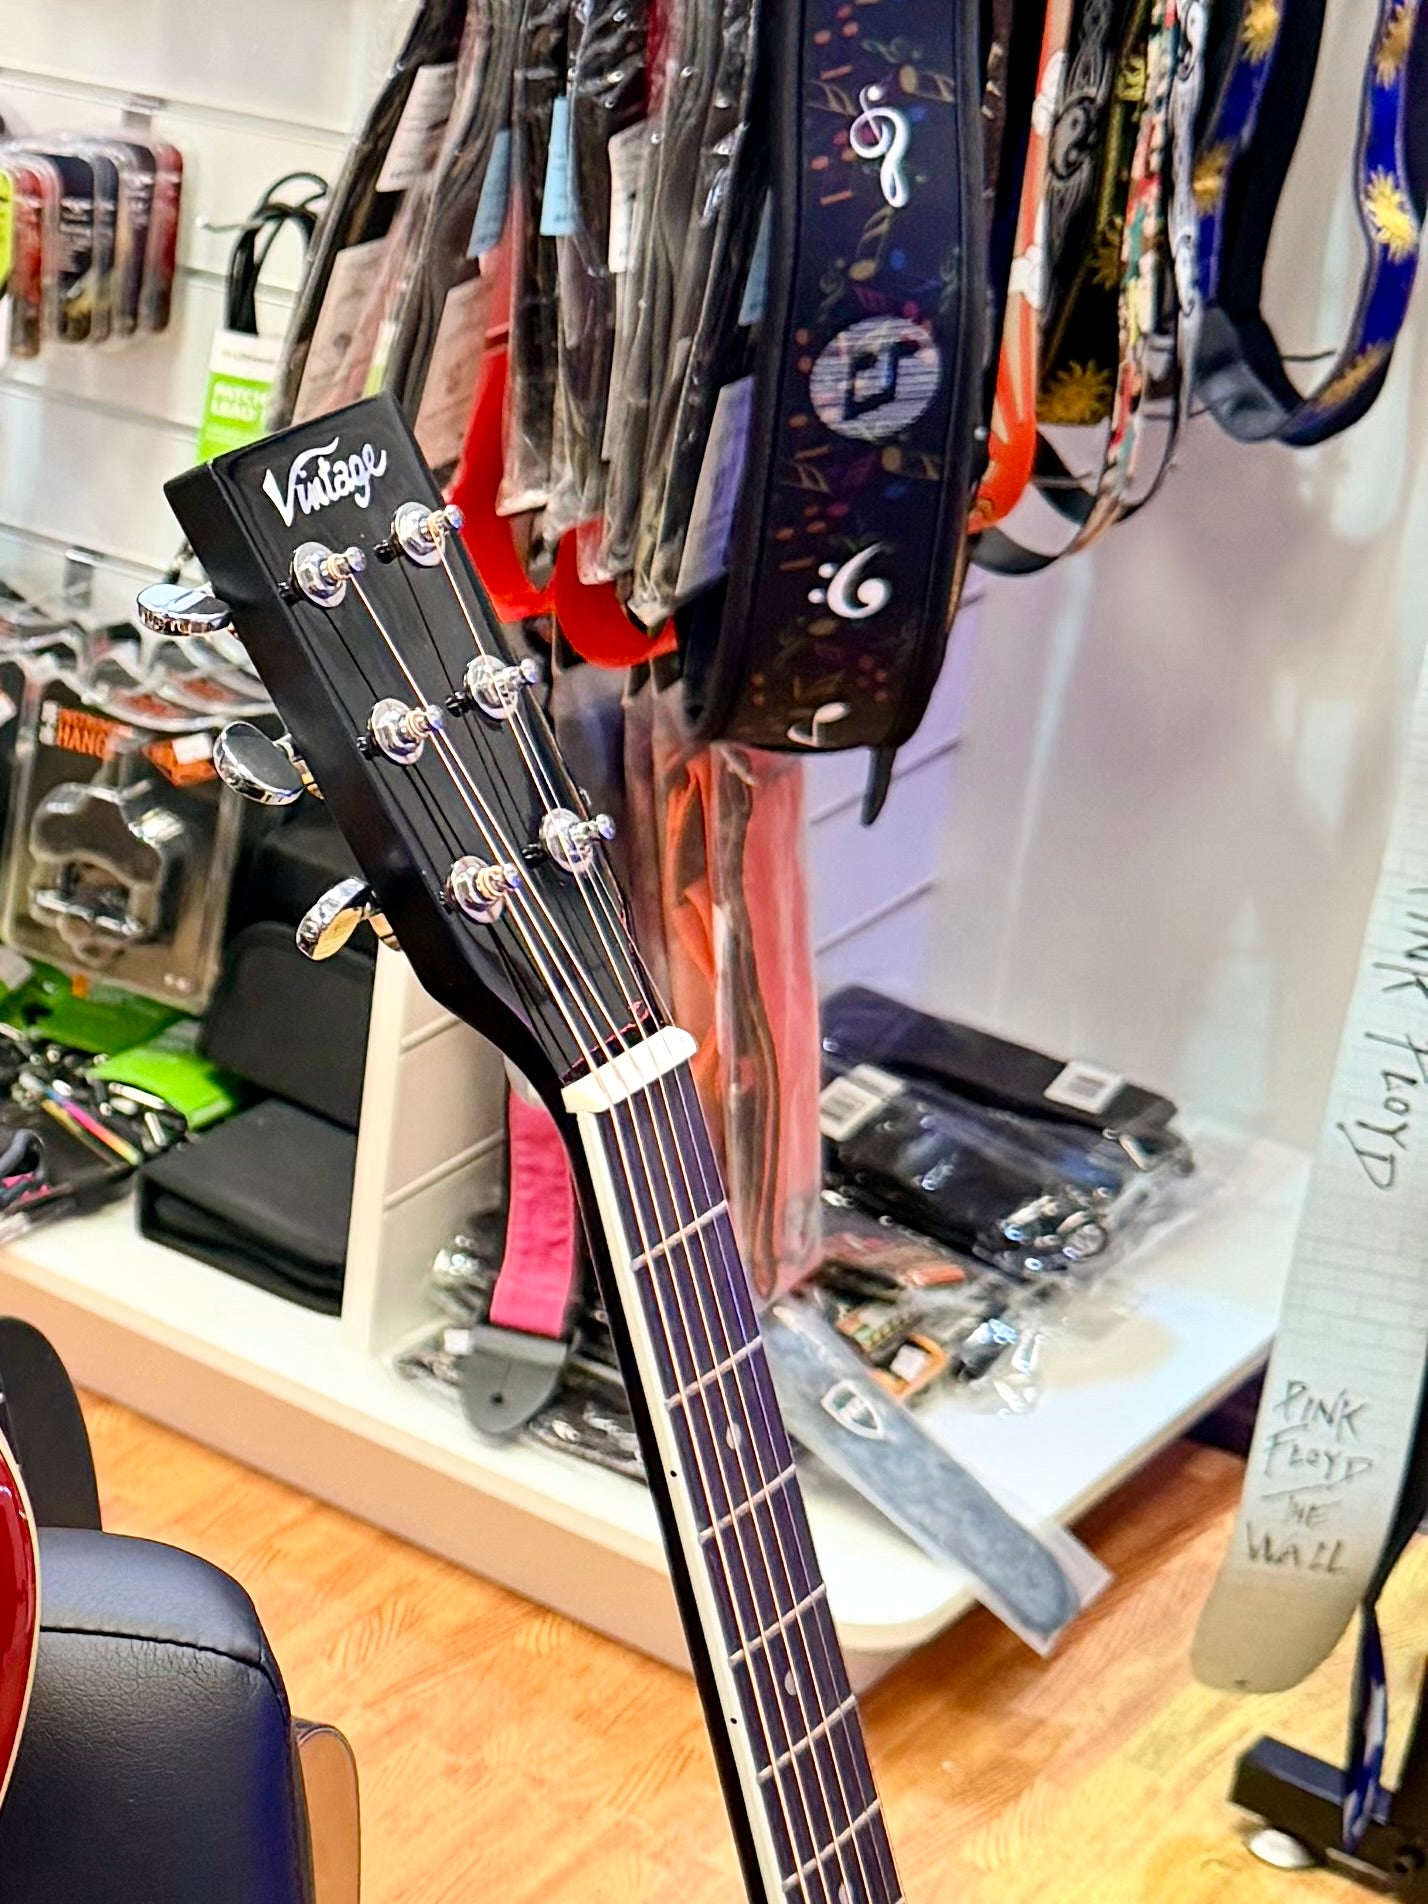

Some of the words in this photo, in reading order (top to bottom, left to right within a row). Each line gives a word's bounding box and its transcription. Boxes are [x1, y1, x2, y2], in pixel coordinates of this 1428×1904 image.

[262, 436, 387, 527] Vintage
[1274, 1379, 1367, 1443] PINK
[1263, 1432, 1374, 1486] FLOYD
